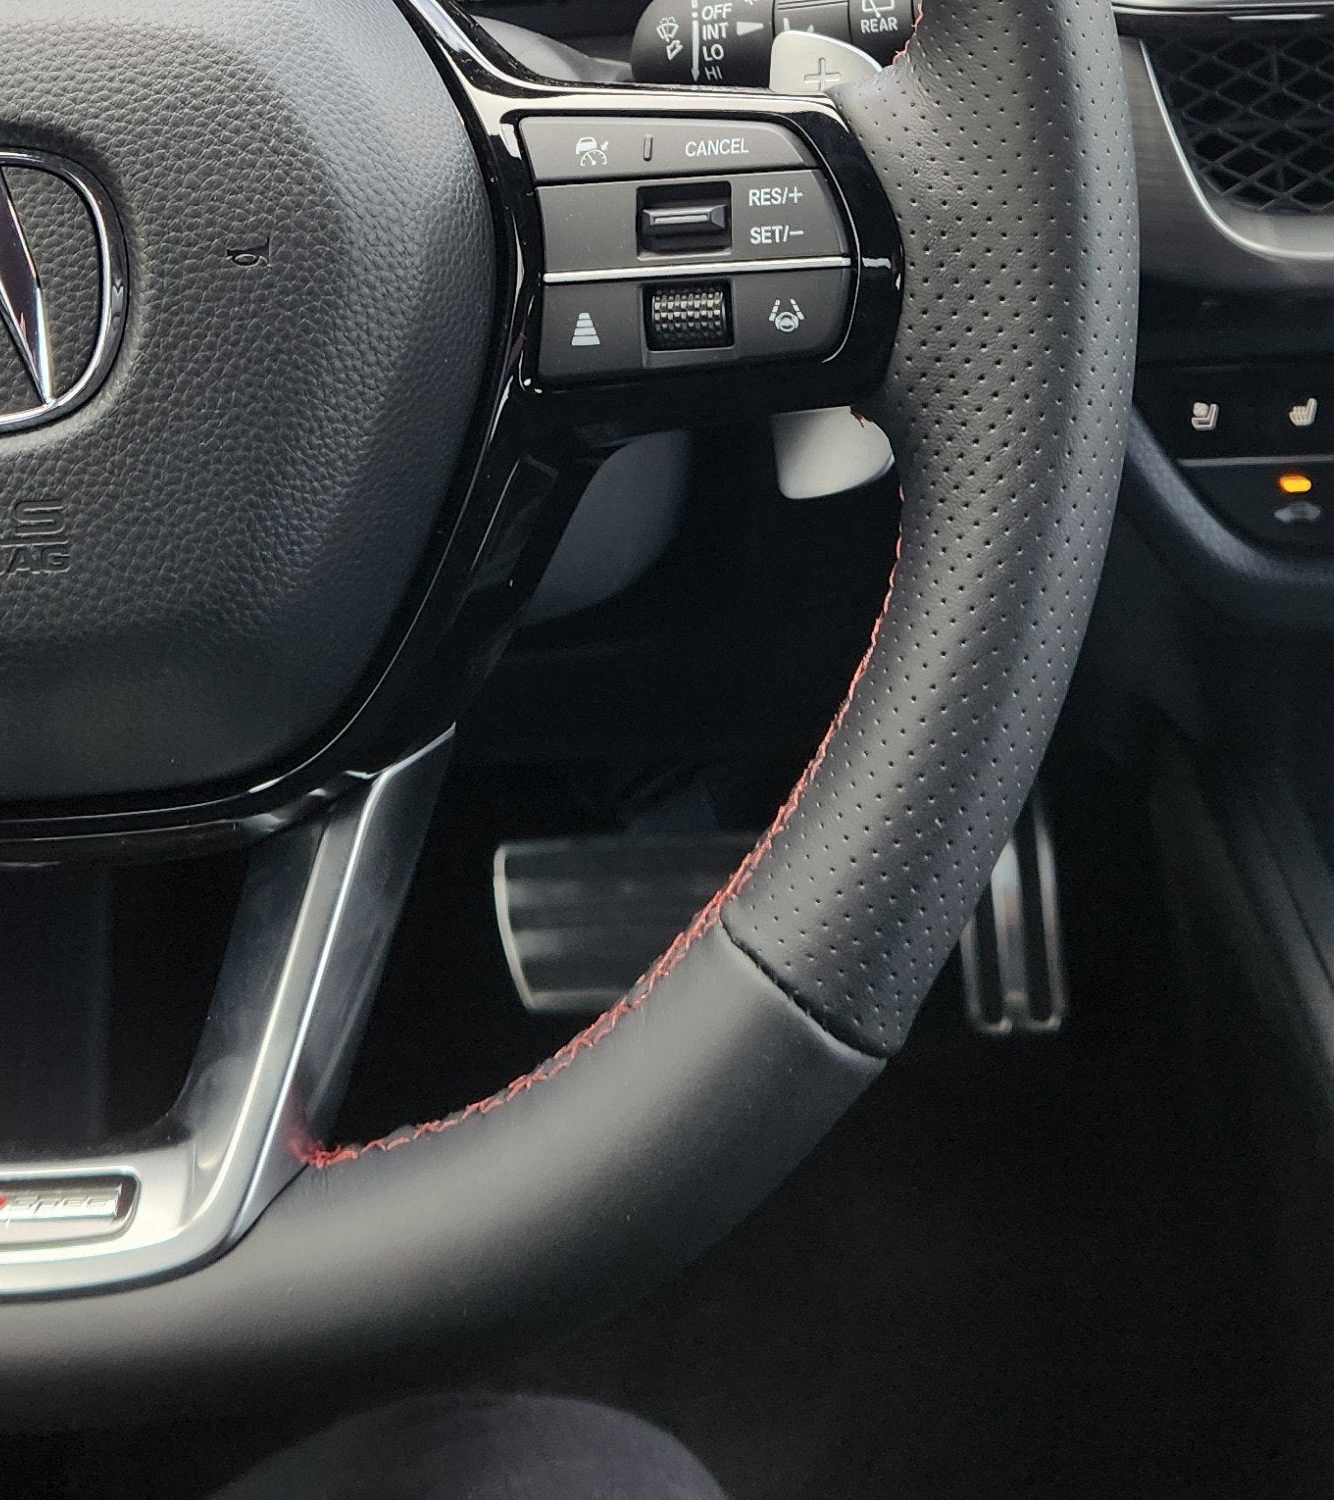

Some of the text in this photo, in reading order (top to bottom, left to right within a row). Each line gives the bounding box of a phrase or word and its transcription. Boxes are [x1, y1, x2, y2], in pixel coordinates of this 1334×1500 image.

[701, 2, 733, 21] OFF
[702, 22, 729, 41] INT
[860, 16, 898, 34] REAR
[702, 43, 725, 62] LO
[704, 65, 723, 81] HI
[685, 137, 750, 157] CANCEL
